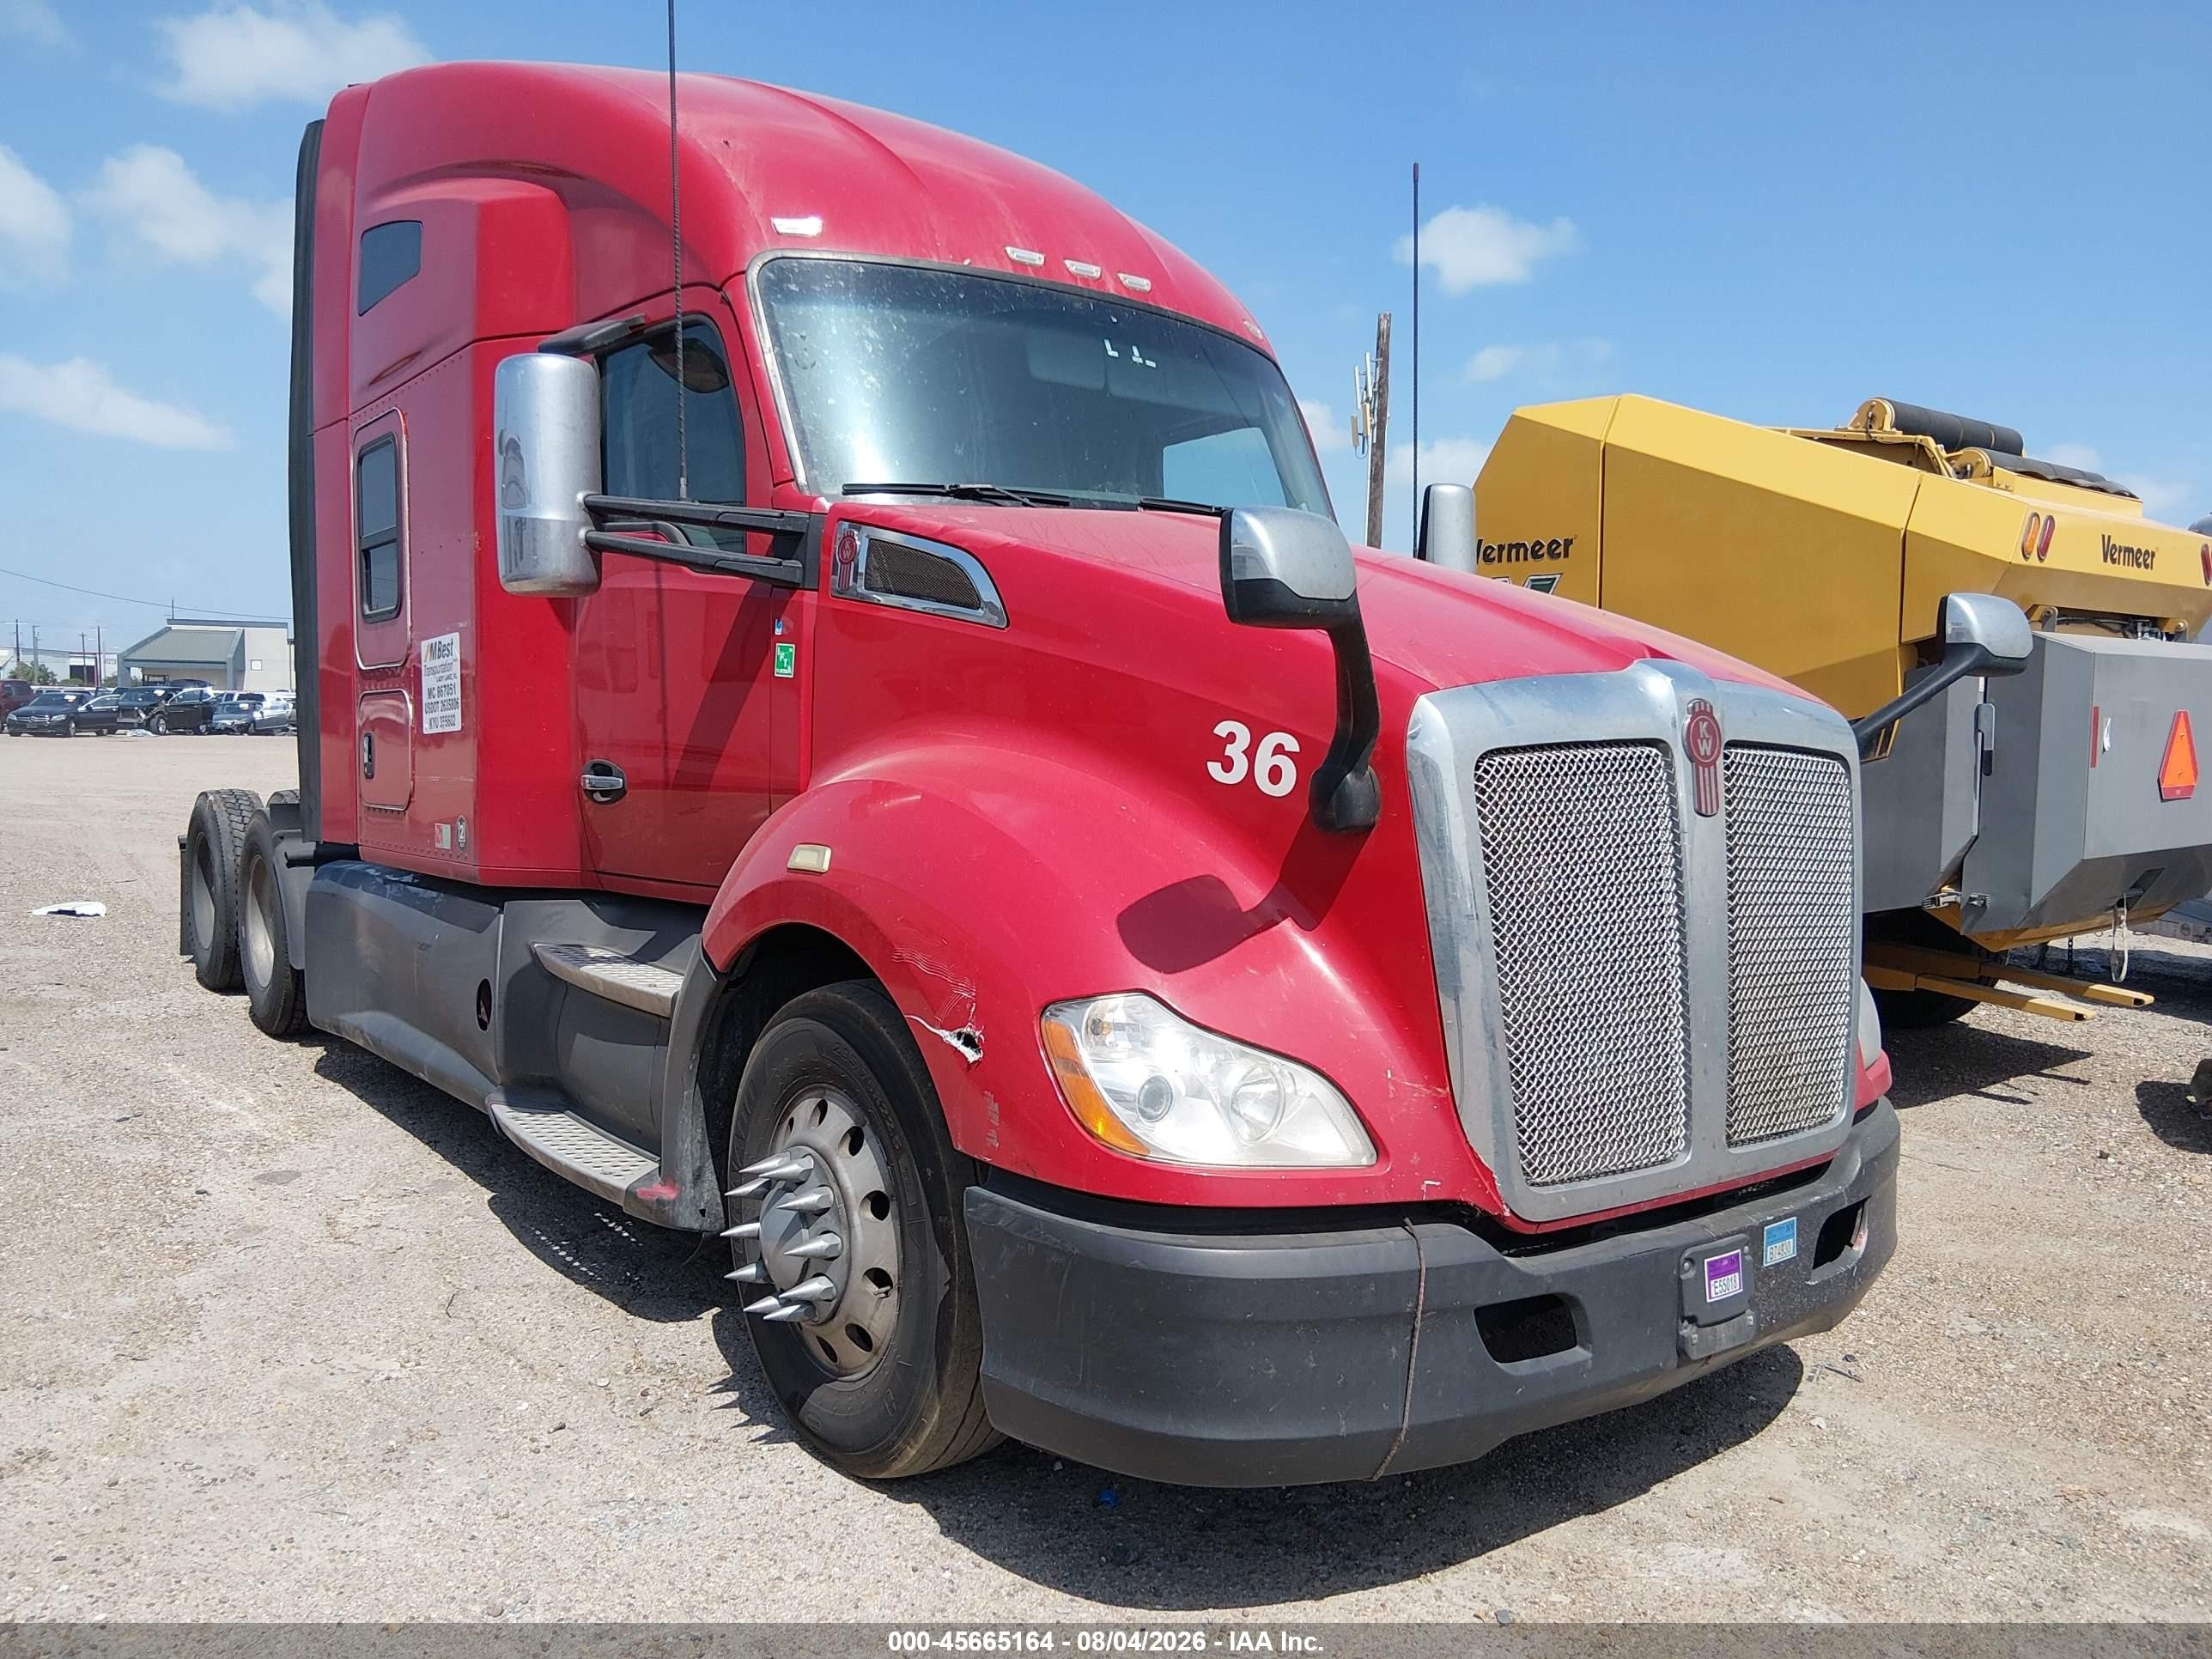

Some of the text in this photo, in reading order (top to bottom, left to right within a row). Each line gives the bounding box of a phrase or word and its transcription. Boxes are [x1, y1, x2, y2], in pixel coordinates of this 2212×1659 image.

[2101, 533, 2156, 571] Vermeer
[423, 662, 453, 678] Transportation
[427, 683, 456, 700] MC 867051
[424, 701, 440, 714] USDOT
[429, 716, 440, 730] KYU
[1206, 720, 1300, 797] 36
[1713, 1274, 1738, 1295] E55018
